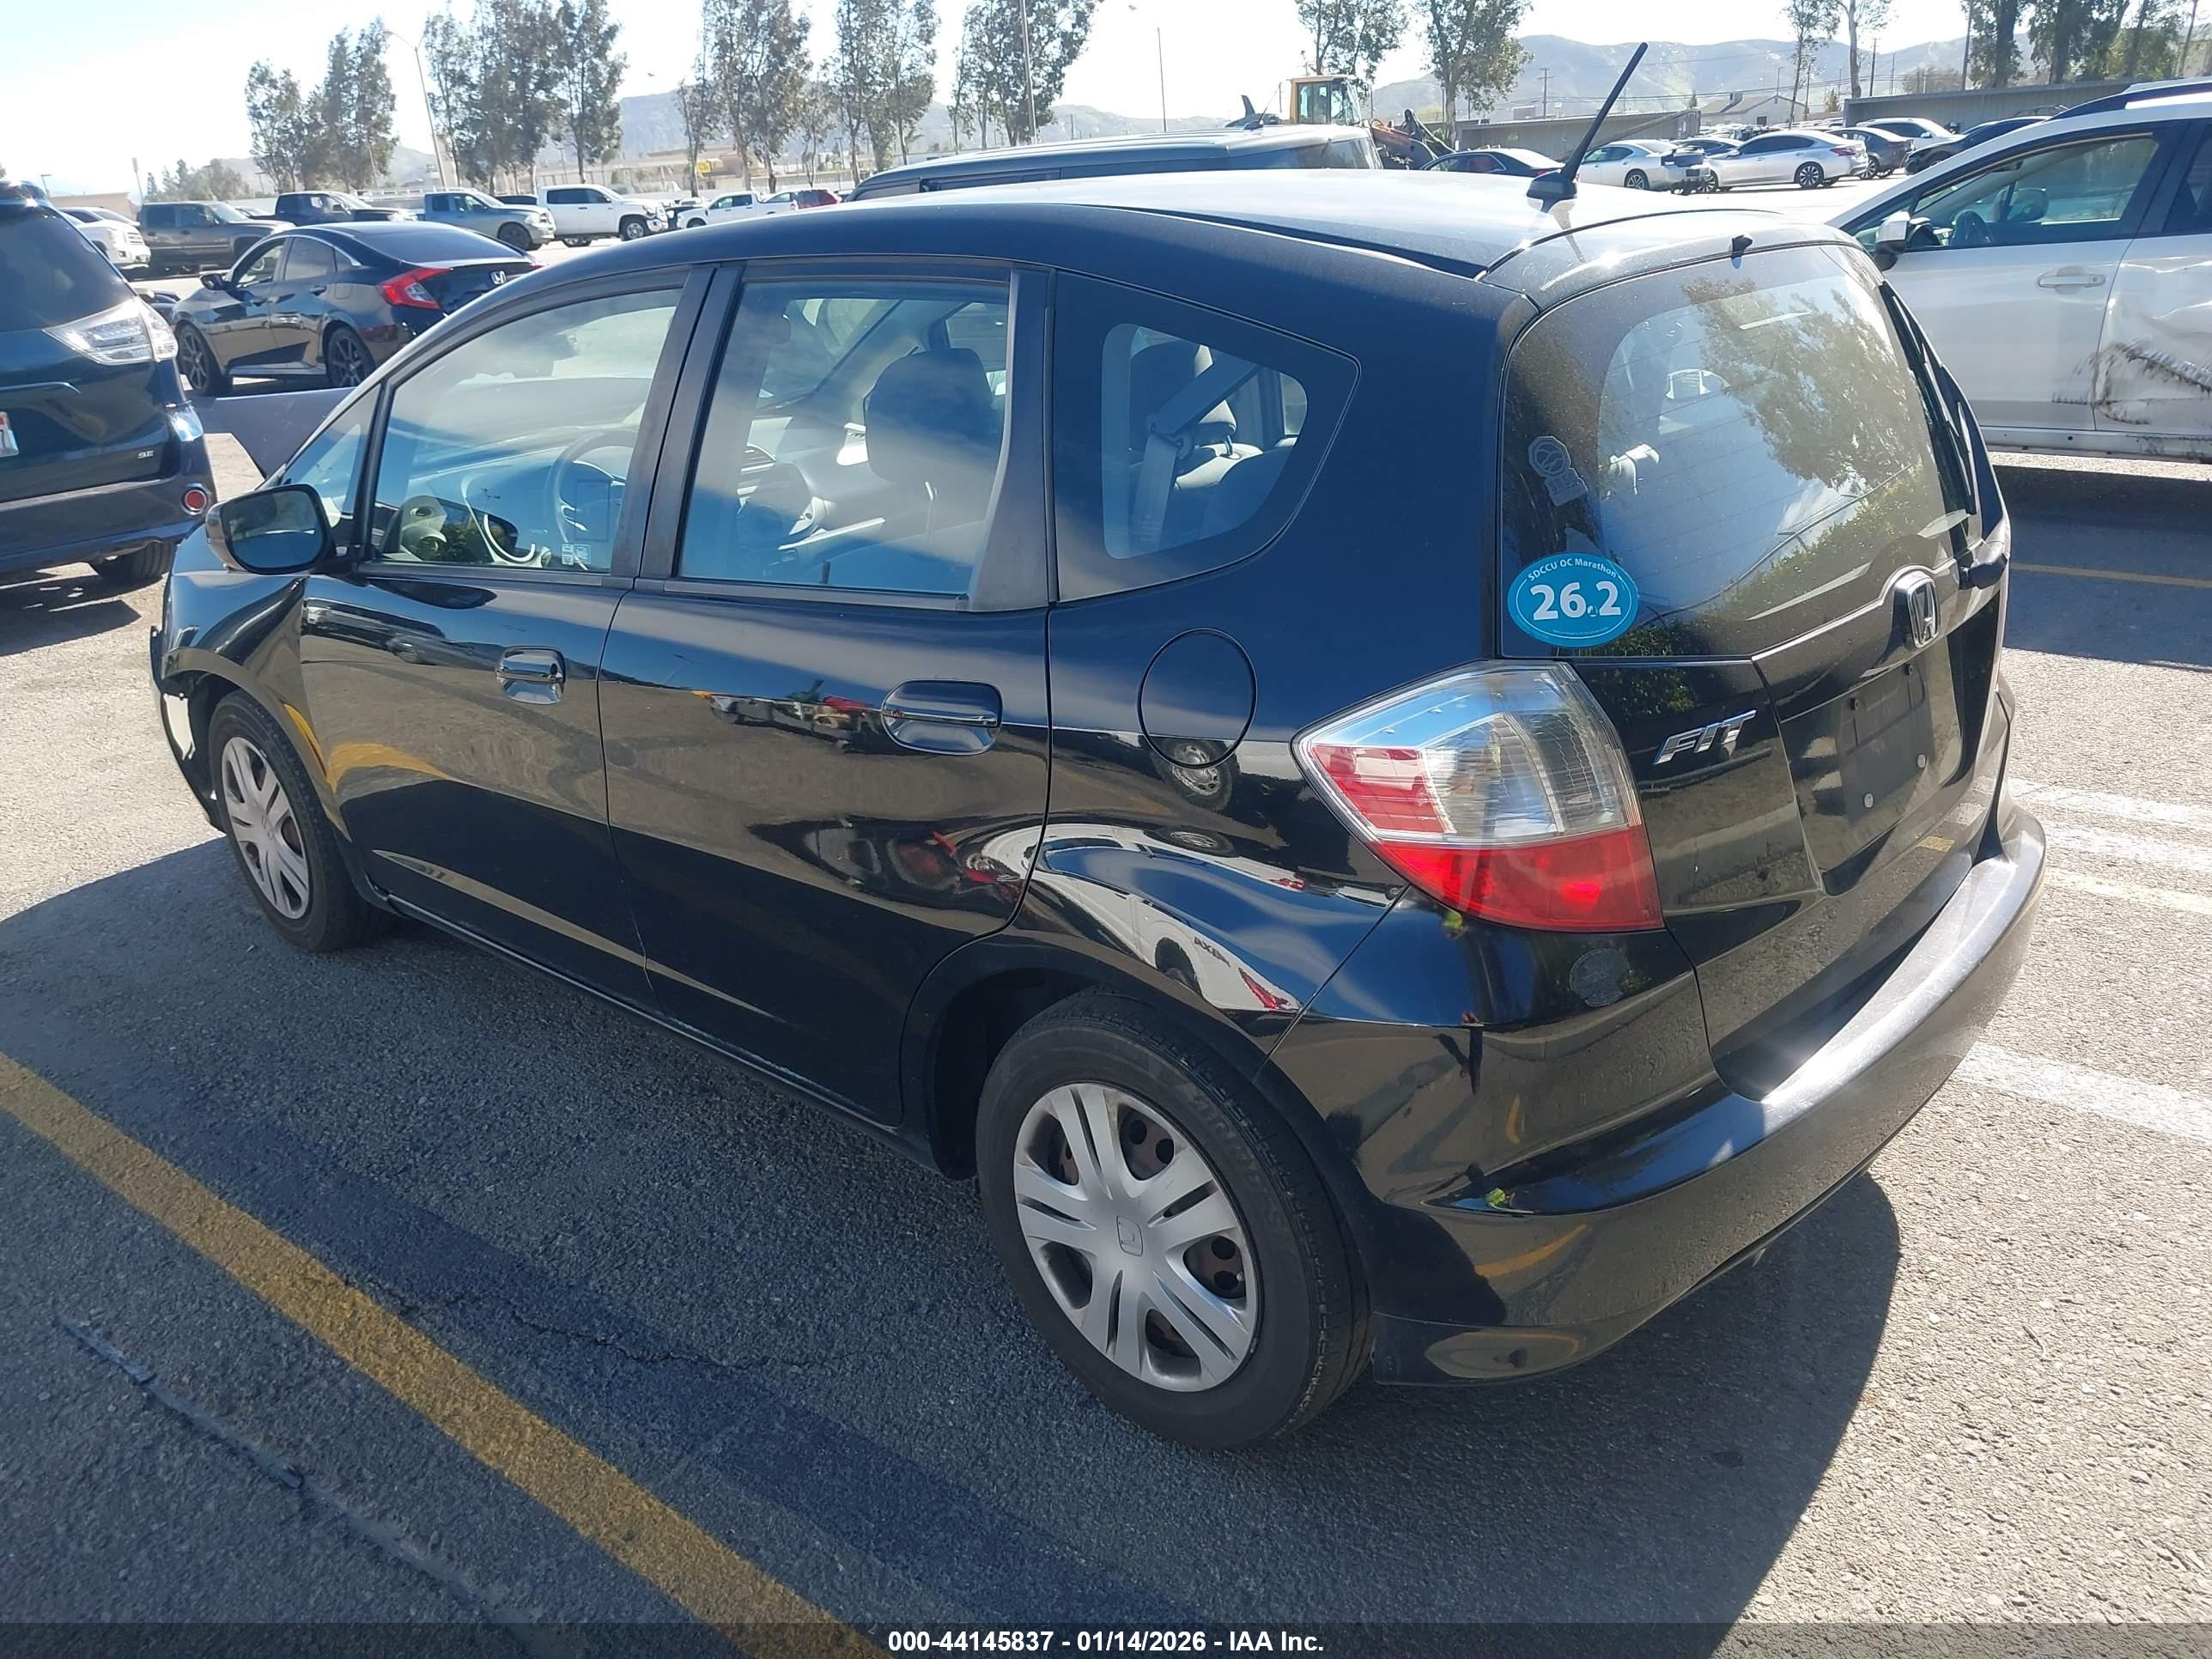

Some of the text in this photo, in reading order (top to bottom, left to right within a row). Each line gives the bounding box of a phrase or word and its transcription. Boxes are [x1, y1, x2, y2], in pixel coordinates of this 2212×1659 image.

[1528, 557, 1616, 582] SDCCU OC Marathon
[1529, 580, 1621, 621] 26.2
[1652, 709, 1757, 765] FIT
